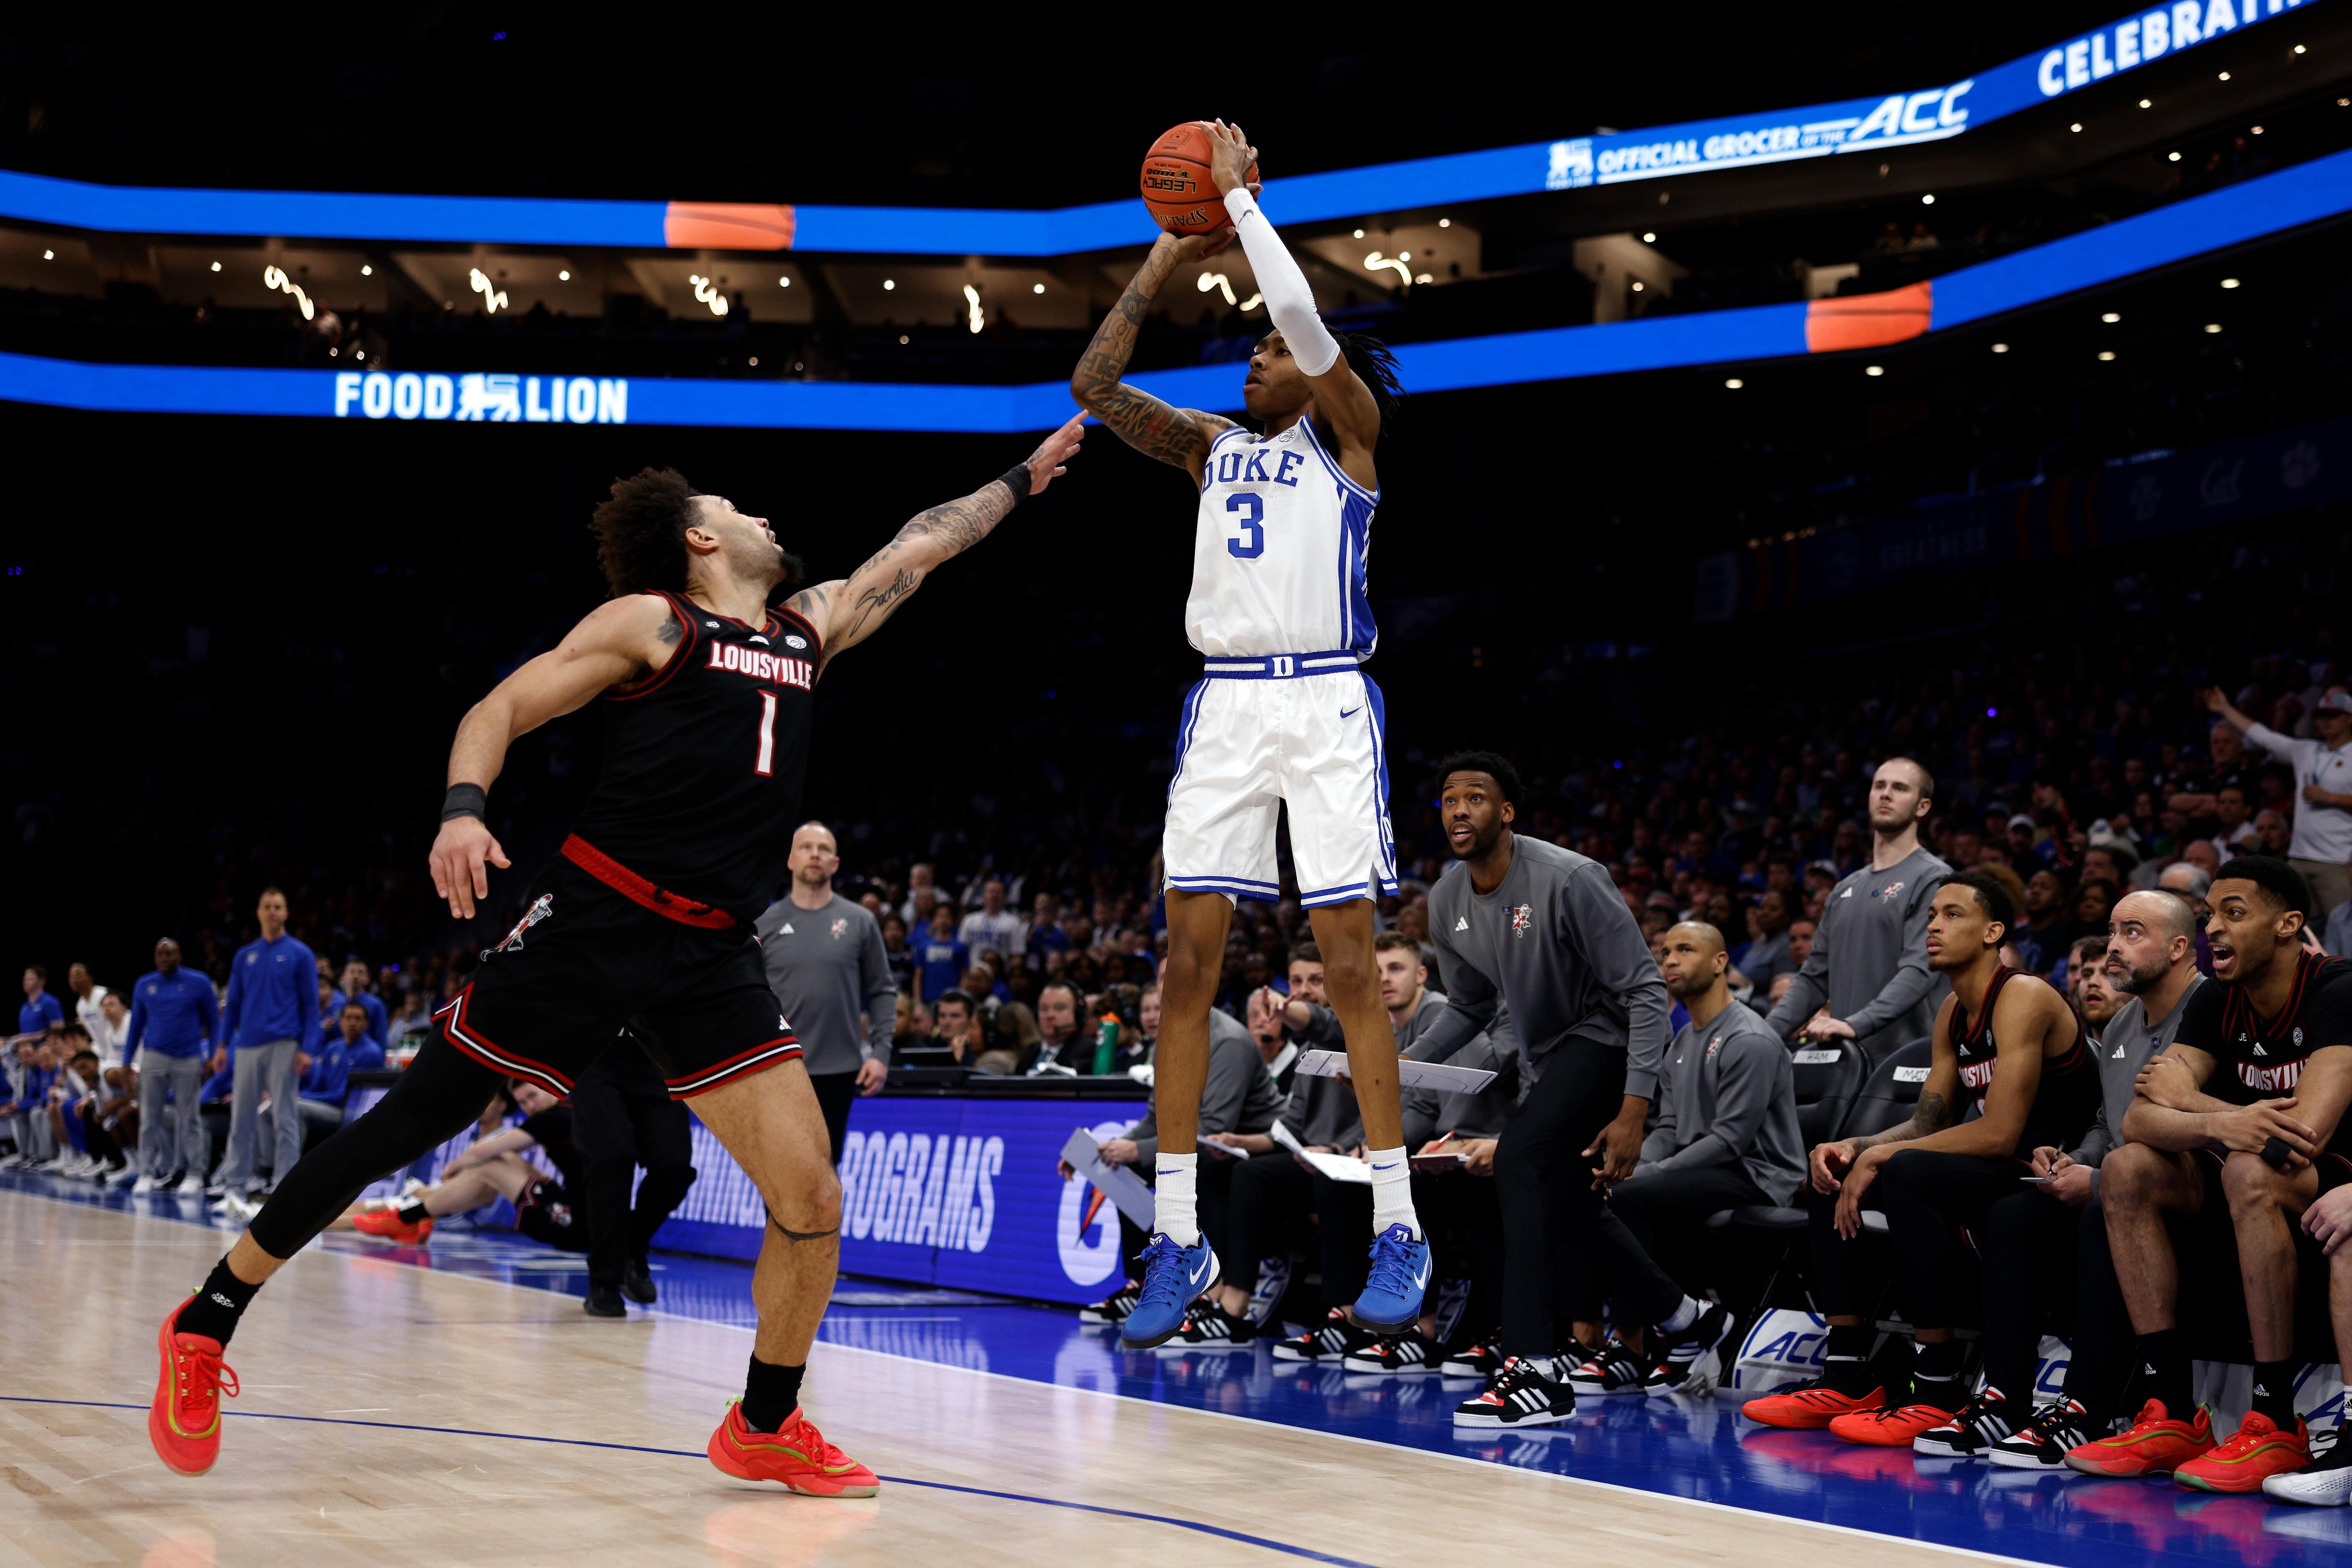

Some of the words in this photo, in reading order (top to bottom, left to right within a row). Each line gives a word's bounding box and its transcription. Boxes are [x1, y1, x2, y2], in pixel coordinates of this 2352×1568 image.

[2037, 0, 2309, 97] CELEBRAT
[1597, 139, 1700, 175] OFFICIAL
[1703, 125, 1800, 160] GROCER
[1848, 79, 1975, 141] ACC
[1143, 176, 1197, 194] LEGACY
[1146, 168, 1176, 178] 1000
[1148, 207, 1209, 226] SPALDIN
[335, 372, 453, 420] FOOD
[525, 377, 628, 424] LION
[1202, 448, 1304, 495] DUKE
[1226, 493, 1264, 559] 3
[849, 568, 920, 638] Sacrifice
[707, 641, 813, 692] LOUISVILLE
[1271, 656, 1294, 677] D
[755, 691, 778, 776] 1
[2238, 1059, 2309, 1091] LOUISVIL
[839, 1130, 1004, 1254] ROGRAMS
[1751, 1331, 1828, 1365] ACC
